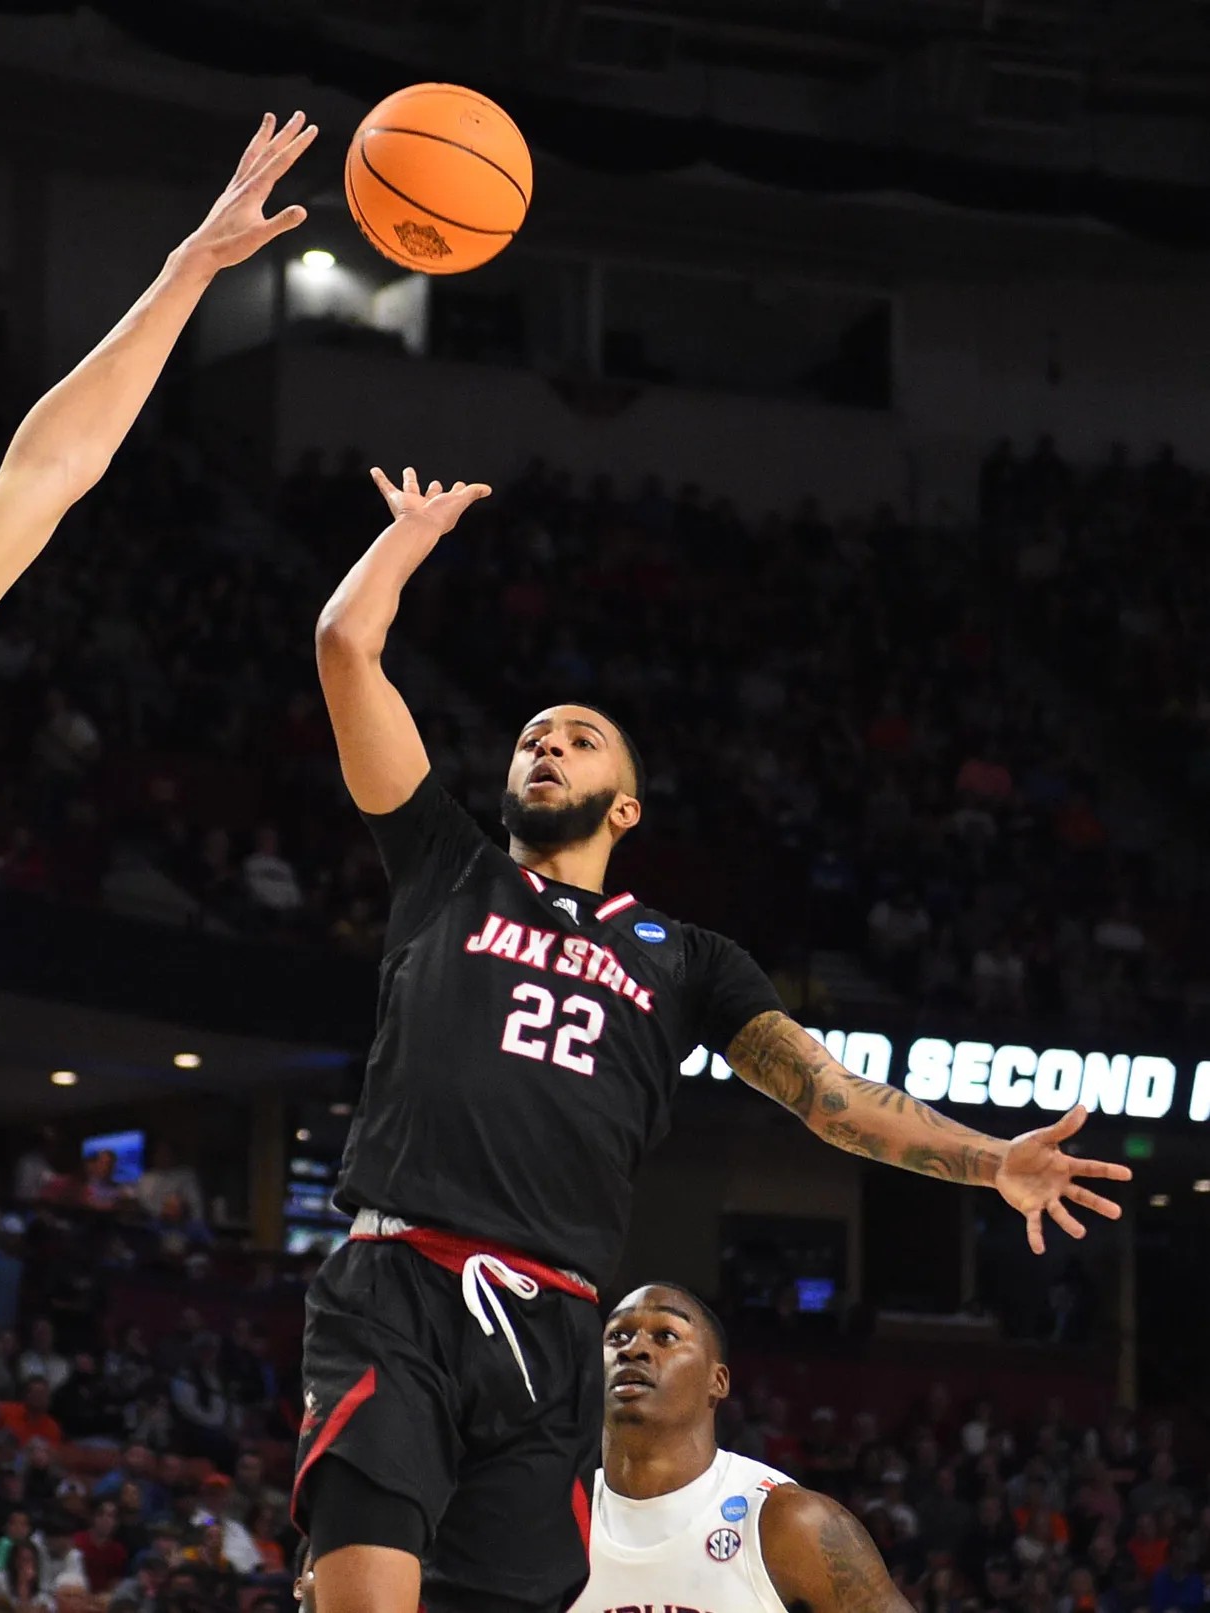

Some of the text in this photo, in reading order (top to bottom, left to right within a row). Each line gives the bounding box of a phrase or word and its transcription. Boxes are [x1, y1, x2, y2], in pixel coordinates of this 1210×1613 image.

[465, 912, 558, 970] JAX
[500, 982, 605, 1076] 22
[904, 1037, 1176, 1119] SECOND
[706, 1528, 742, 1561] SEC
